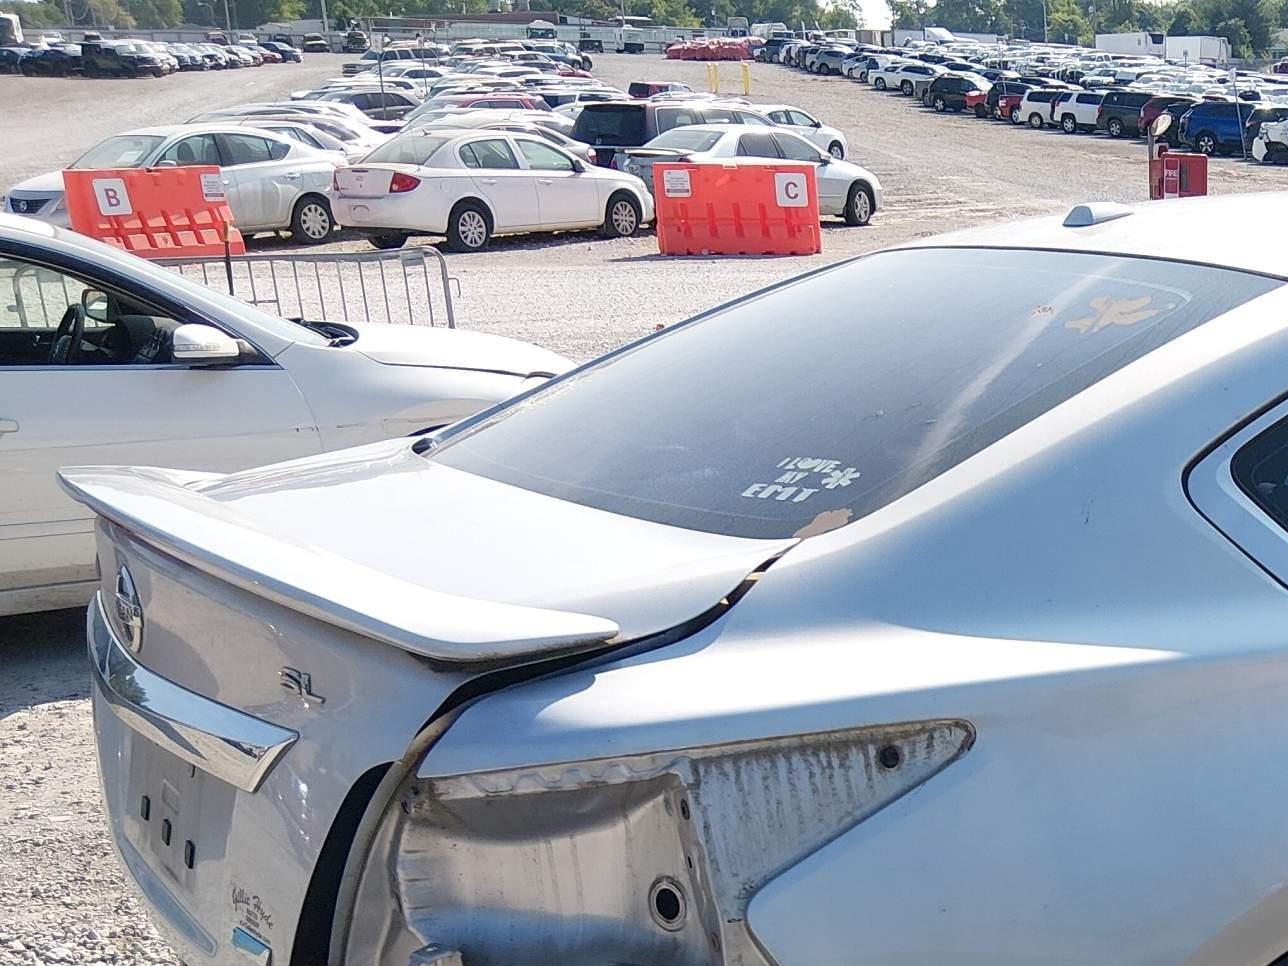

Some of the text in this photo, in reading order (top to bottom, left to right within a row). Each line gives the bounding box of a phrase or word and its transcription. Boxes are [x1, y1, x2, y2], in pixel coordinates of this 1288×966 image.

[104, 188, 121, 207] B
[784, 181, 799, 200] C
[776, 457, 791, 468] I
[775, 471, 809, 484] MY
[741, 483, 820, 503] EMT
[279, 665, 327, 704] SL
